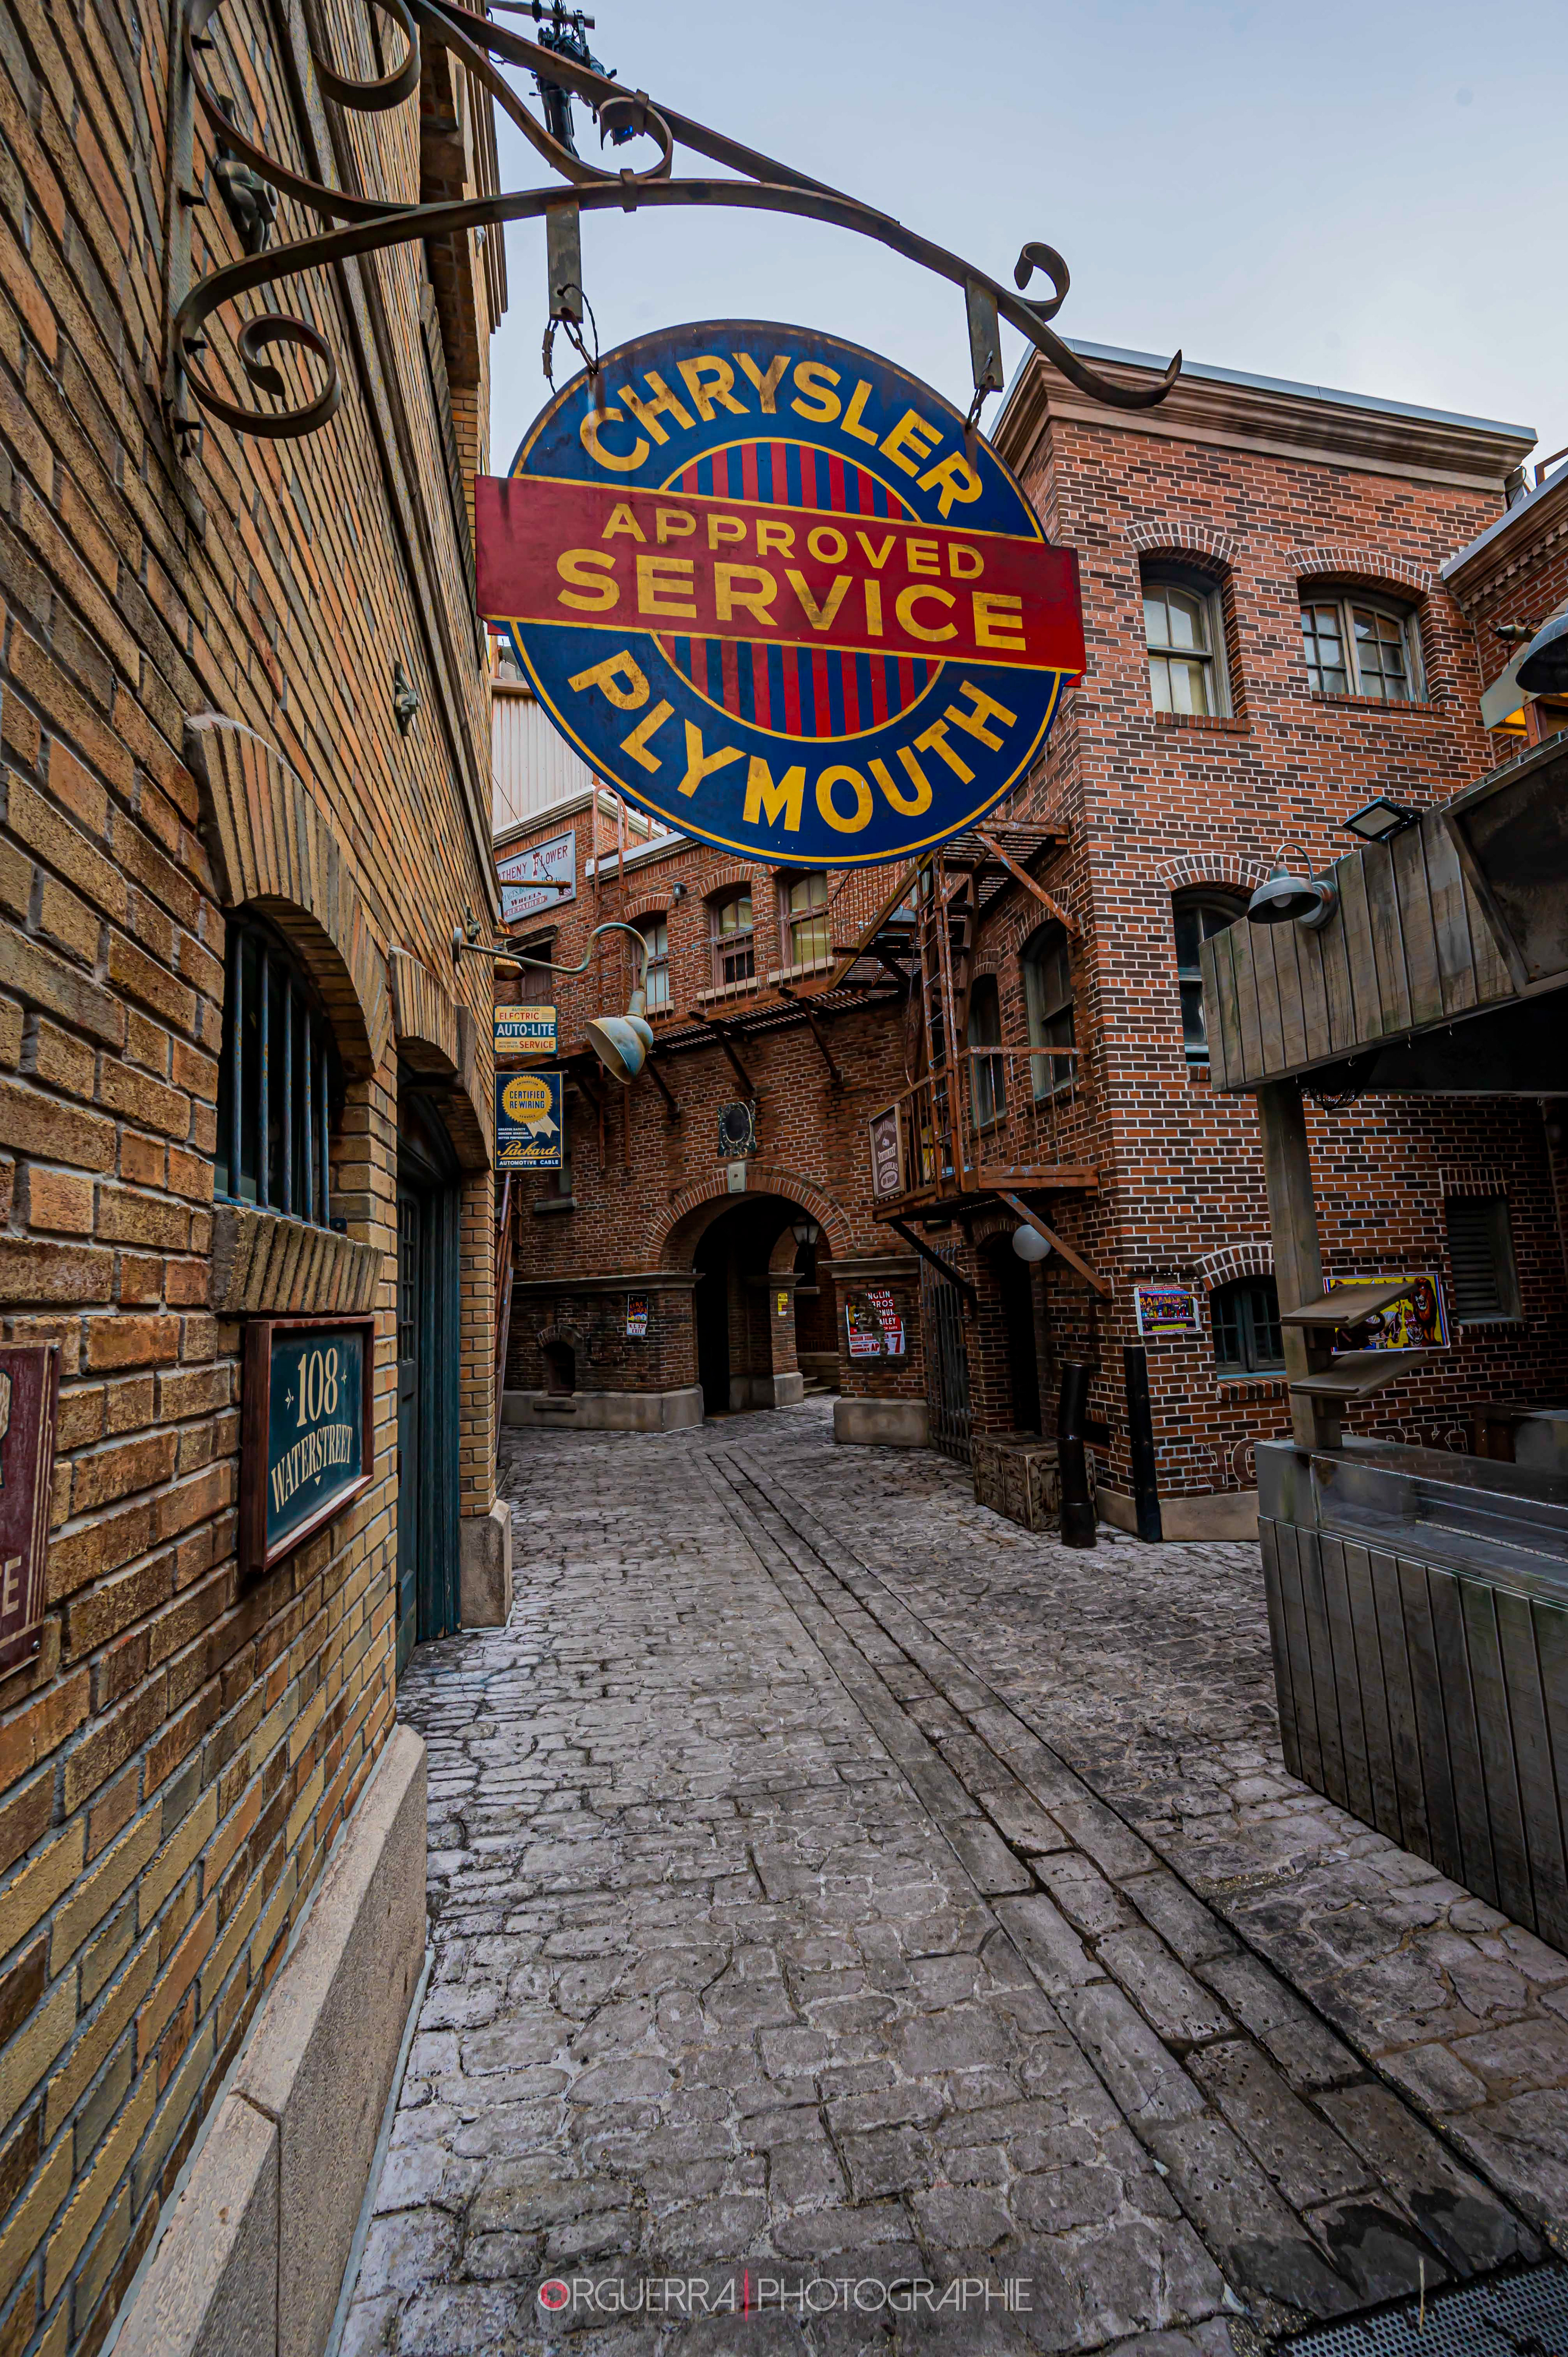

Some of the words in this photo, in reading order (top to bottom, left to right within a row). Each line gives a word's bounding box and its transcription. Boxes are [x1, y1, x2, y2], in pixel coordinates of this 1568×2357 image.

[579, 352, 983, 519] CHRYSLER
[601, 503, 984, 580] APPROVED
[556, 549, 1027, 651] SERVICE
[567, 649, 1018, 833] PLYMOUTH
[497, 1024, 555, 1036] AUTO-LITE
[510, 1091, 545, 1099] CERTIFIED
[497, 1140, 561, 1156] Packard
[891, 1333, 902, 1354] 7
[296, 1347, 338, 1427] 108
